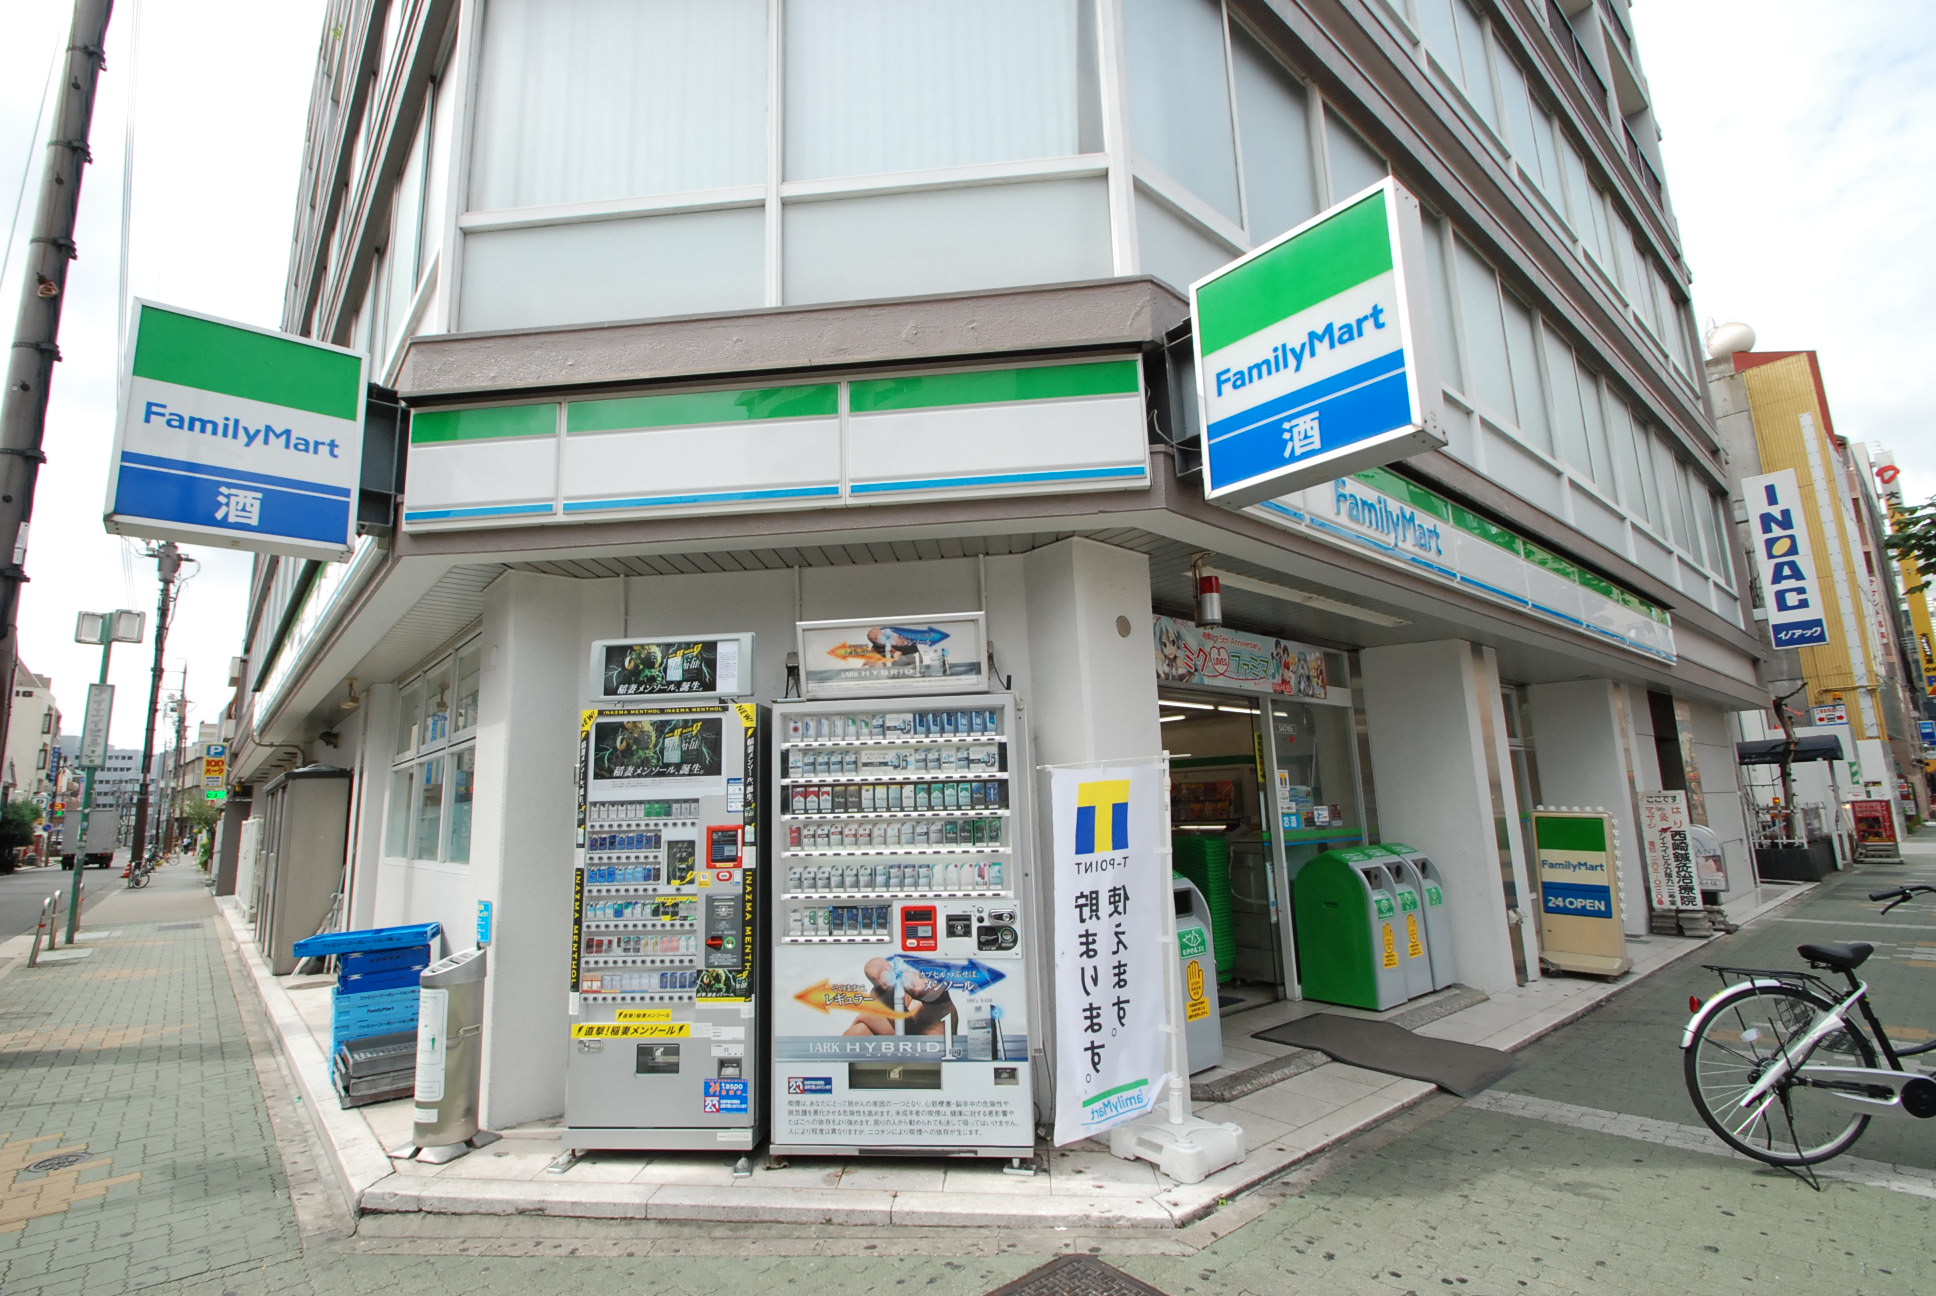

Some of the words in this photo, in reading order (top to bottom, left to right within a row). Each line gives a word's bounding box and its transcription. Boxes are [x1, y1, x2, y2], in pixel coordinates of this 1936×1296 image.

[1215, 303, 1386, 397] FamilyMart
[143, 401, 340, 459] FamilyMart
[1281, 410, 1322, 459] 酒
[214, 485, 263, 527] 酒
[1333, 478, 1443, 556] FamilyMart
[1758, 483, 1810, 613] INOAC
[1230, 637, 1262, 652] Anniversary
[1777, 626, 1822, 641] イノアック
[1182, 642, 1209, 673] ミク
[1213, 657, 1228, 666] LOVES
[1230, 653, 1271, 678] ファミマ
[861, 668, 914, 677] HYBRID
[736, 704, 754, 723] NEW!
[210, 745, 223, 755] P
[1646, 795, 1677, 804] ここです
[1671, 806, 1683, 829] はり
[1541, 859, 1605, 872] FamilyMart
[573, 871, 582, 919] INAZMA
[745, 871, 753, 921] INAZMA
[744, 926, 752, 971] MENTH
[924, 979, 975, 992] メンソール
[824, 994, 874, 1006] レギュラー
[809, 1042, 840, 1053] LARK
[846, 1041, 940, 1053] HYBRID
[940, 1013, 957, 1061] 1
[721, 1082, 743, 1091] taspo
